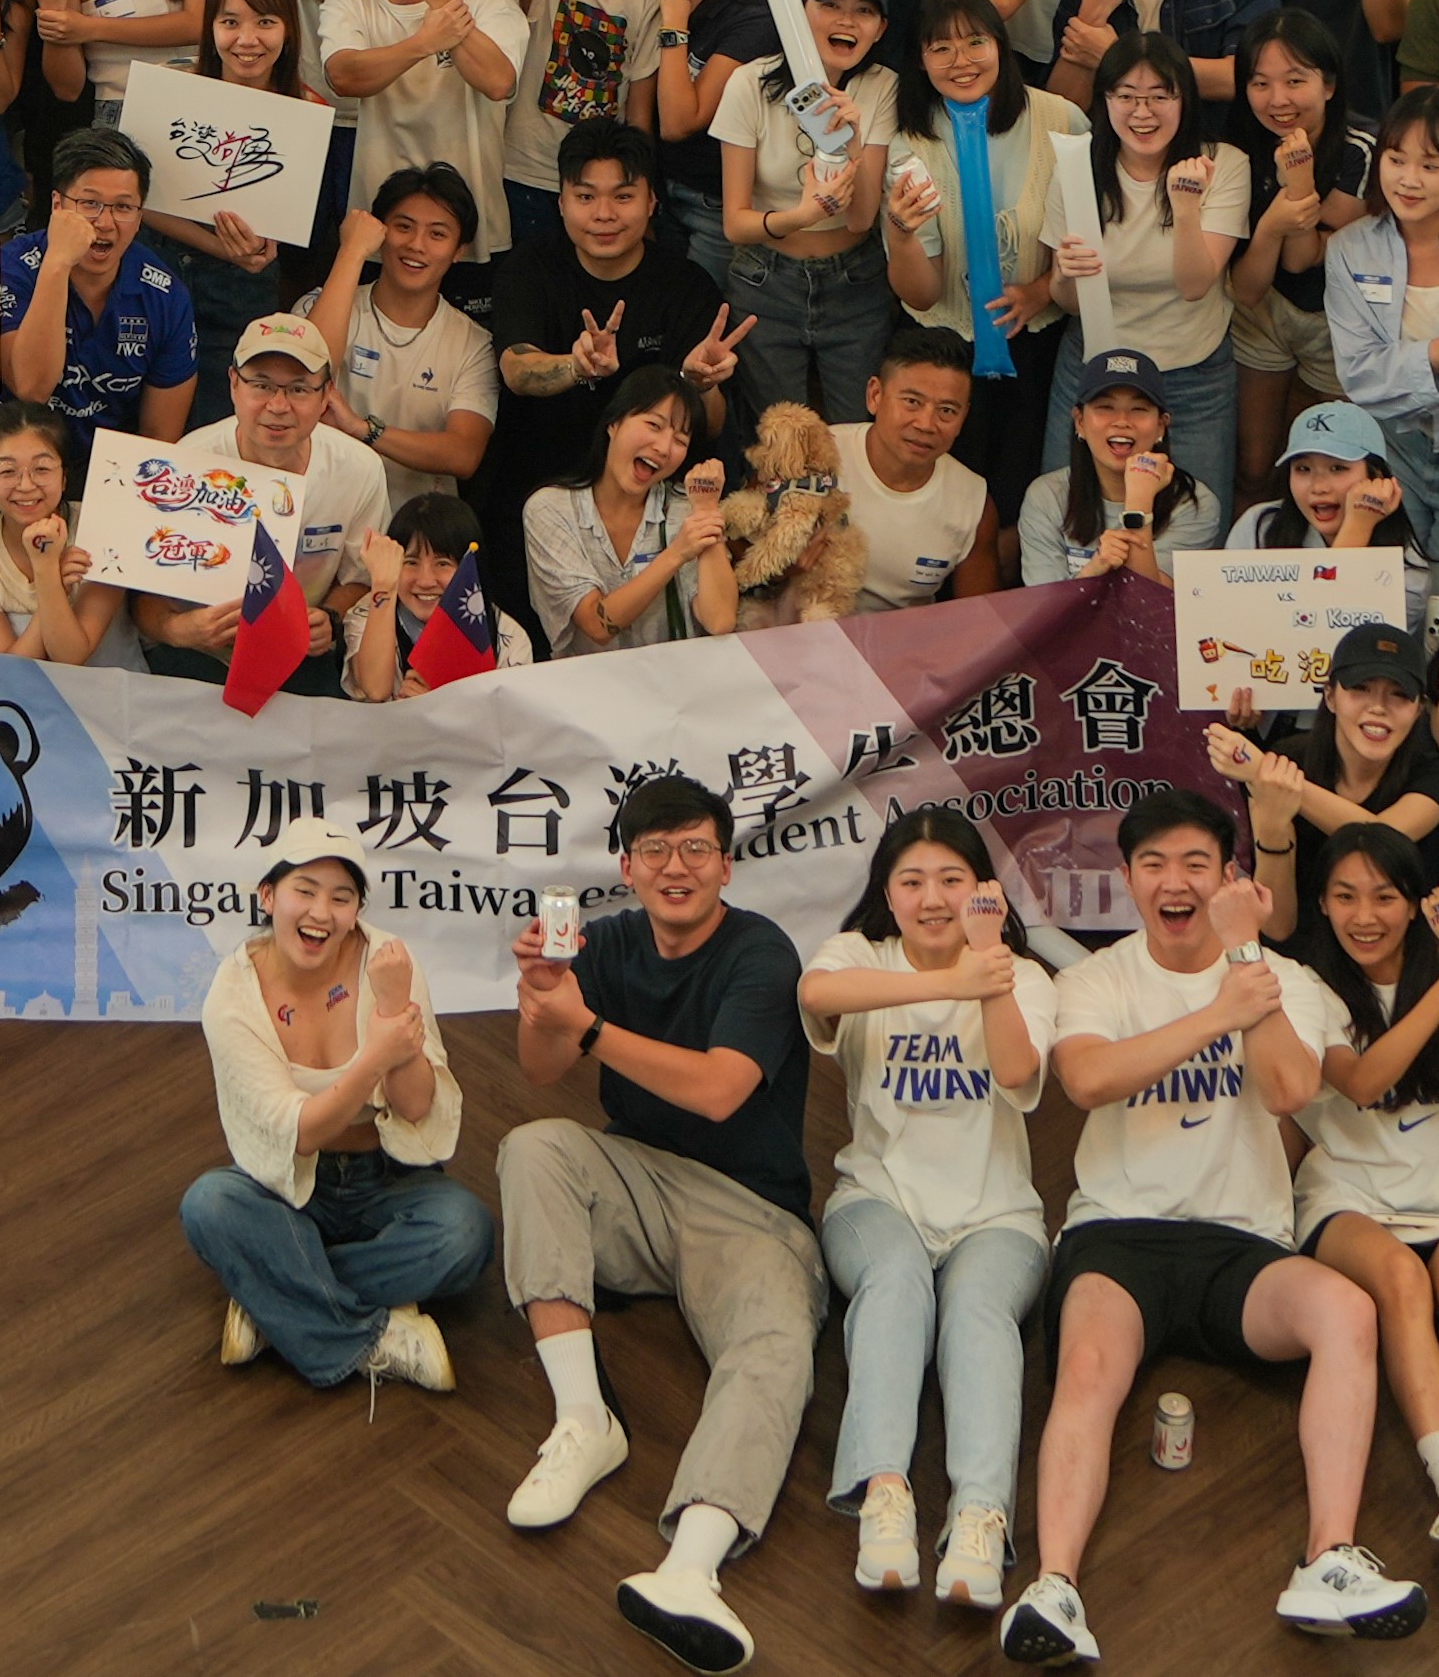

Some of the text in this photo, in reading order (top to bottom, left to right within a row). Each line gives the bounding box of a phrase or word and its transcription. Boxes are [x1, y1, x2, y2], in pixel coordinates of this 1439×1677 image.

[142, 266, 174, 288] OMP
[115, 342, 146, 357] IWC
[145, 468, 249, 515] 台灣加油
[154, 534, 216, 572] 冠軍
[1221, 564, 1300, 583] TAIWAN
[1326, 607, 1385, 628] Korea
[888, 1034, 963, 1063] TEAM
